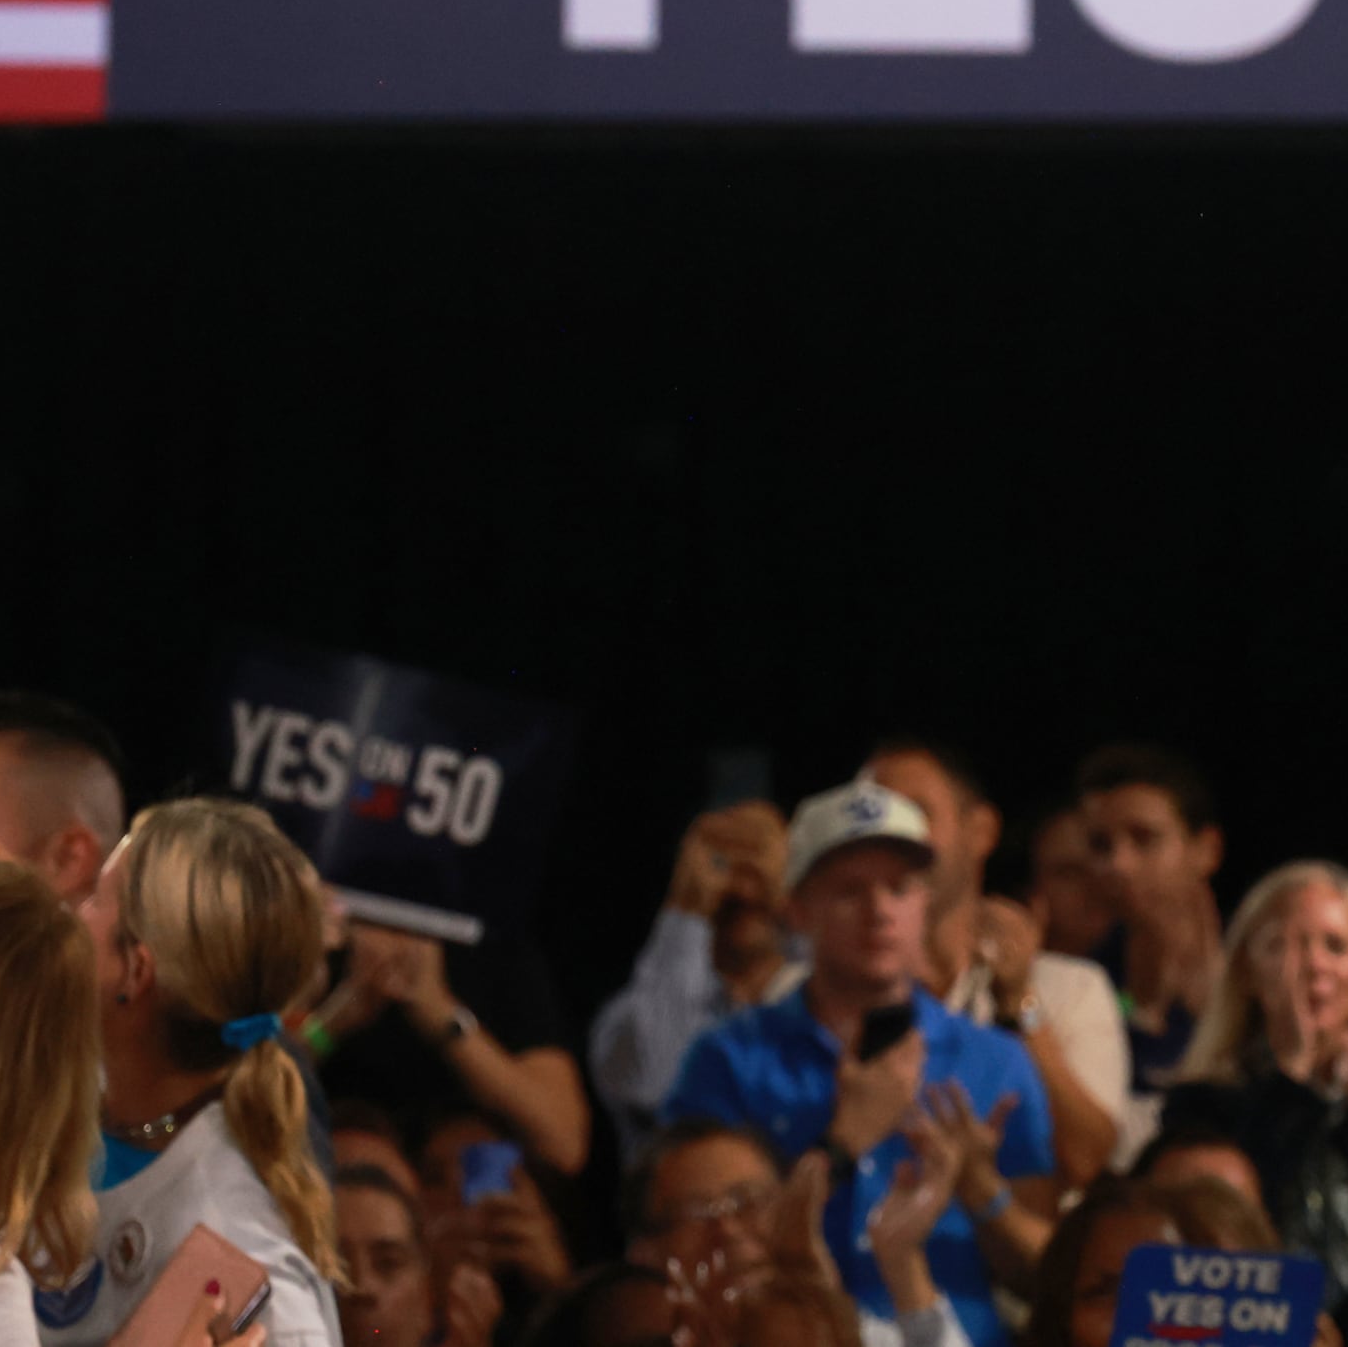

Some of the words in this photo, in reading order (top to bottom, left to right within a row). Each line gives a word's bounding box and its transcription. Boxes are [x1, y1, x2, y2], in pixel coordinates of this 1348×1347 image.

[230, 701, 352, 809] YES
[359, 738, 412, 783] ON
[405, 743, 502, 846] 50
[1173, 1254, 1282, 1294] VOTE
[1150, 1292, 1224, 1329] YES
[1230, 1298, 1290, 1336] ON
